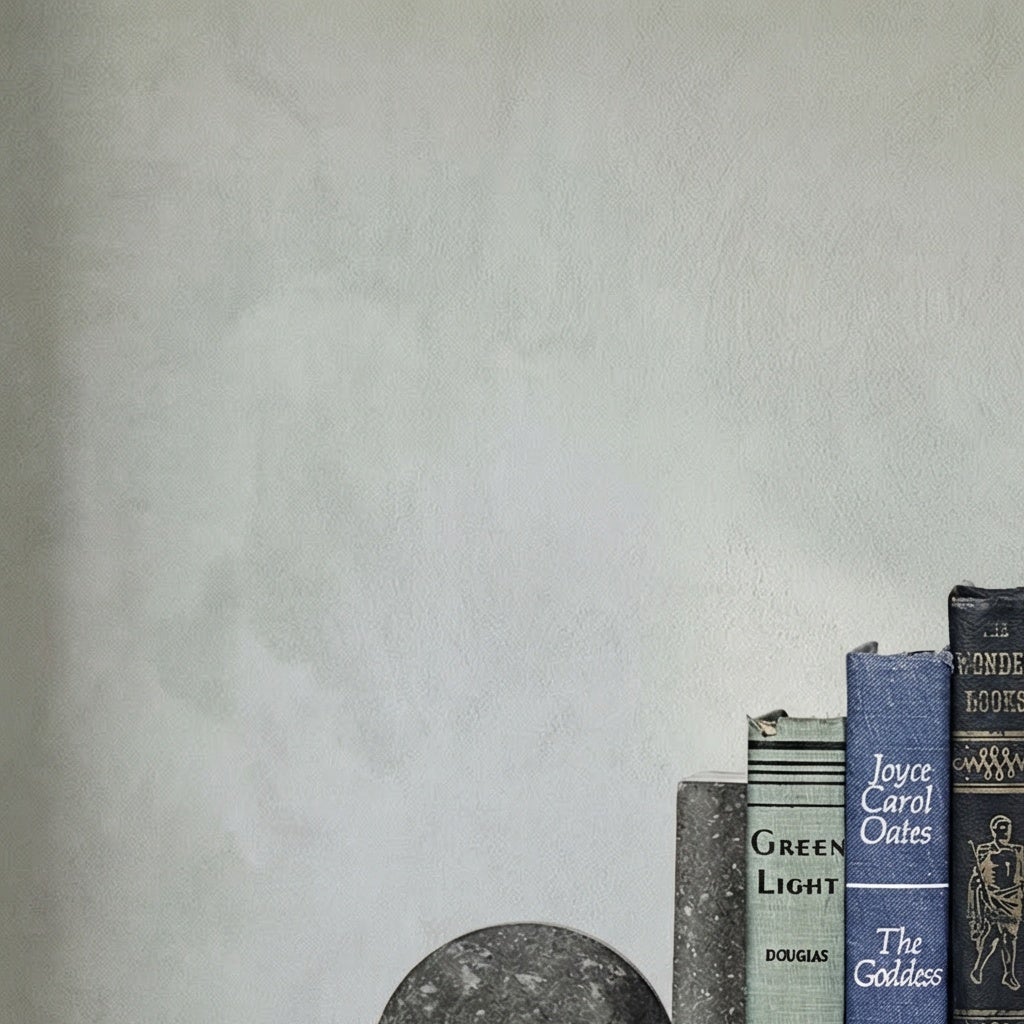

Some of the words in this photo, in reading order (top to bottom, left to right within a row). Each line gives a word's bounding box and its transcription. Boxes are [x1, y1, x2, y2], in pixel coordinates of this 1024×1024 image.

[868, 753, 932, 788] Joyce
[861, 785, 932, 814] Carol
[751, 828, 845, 856] GREEN
[860, 815, 932, 845] Oates
[758, 869, 839, 894] LIGHT
[876, 926, 923, 955] The
[853, 958, 944, 988] Goddess
